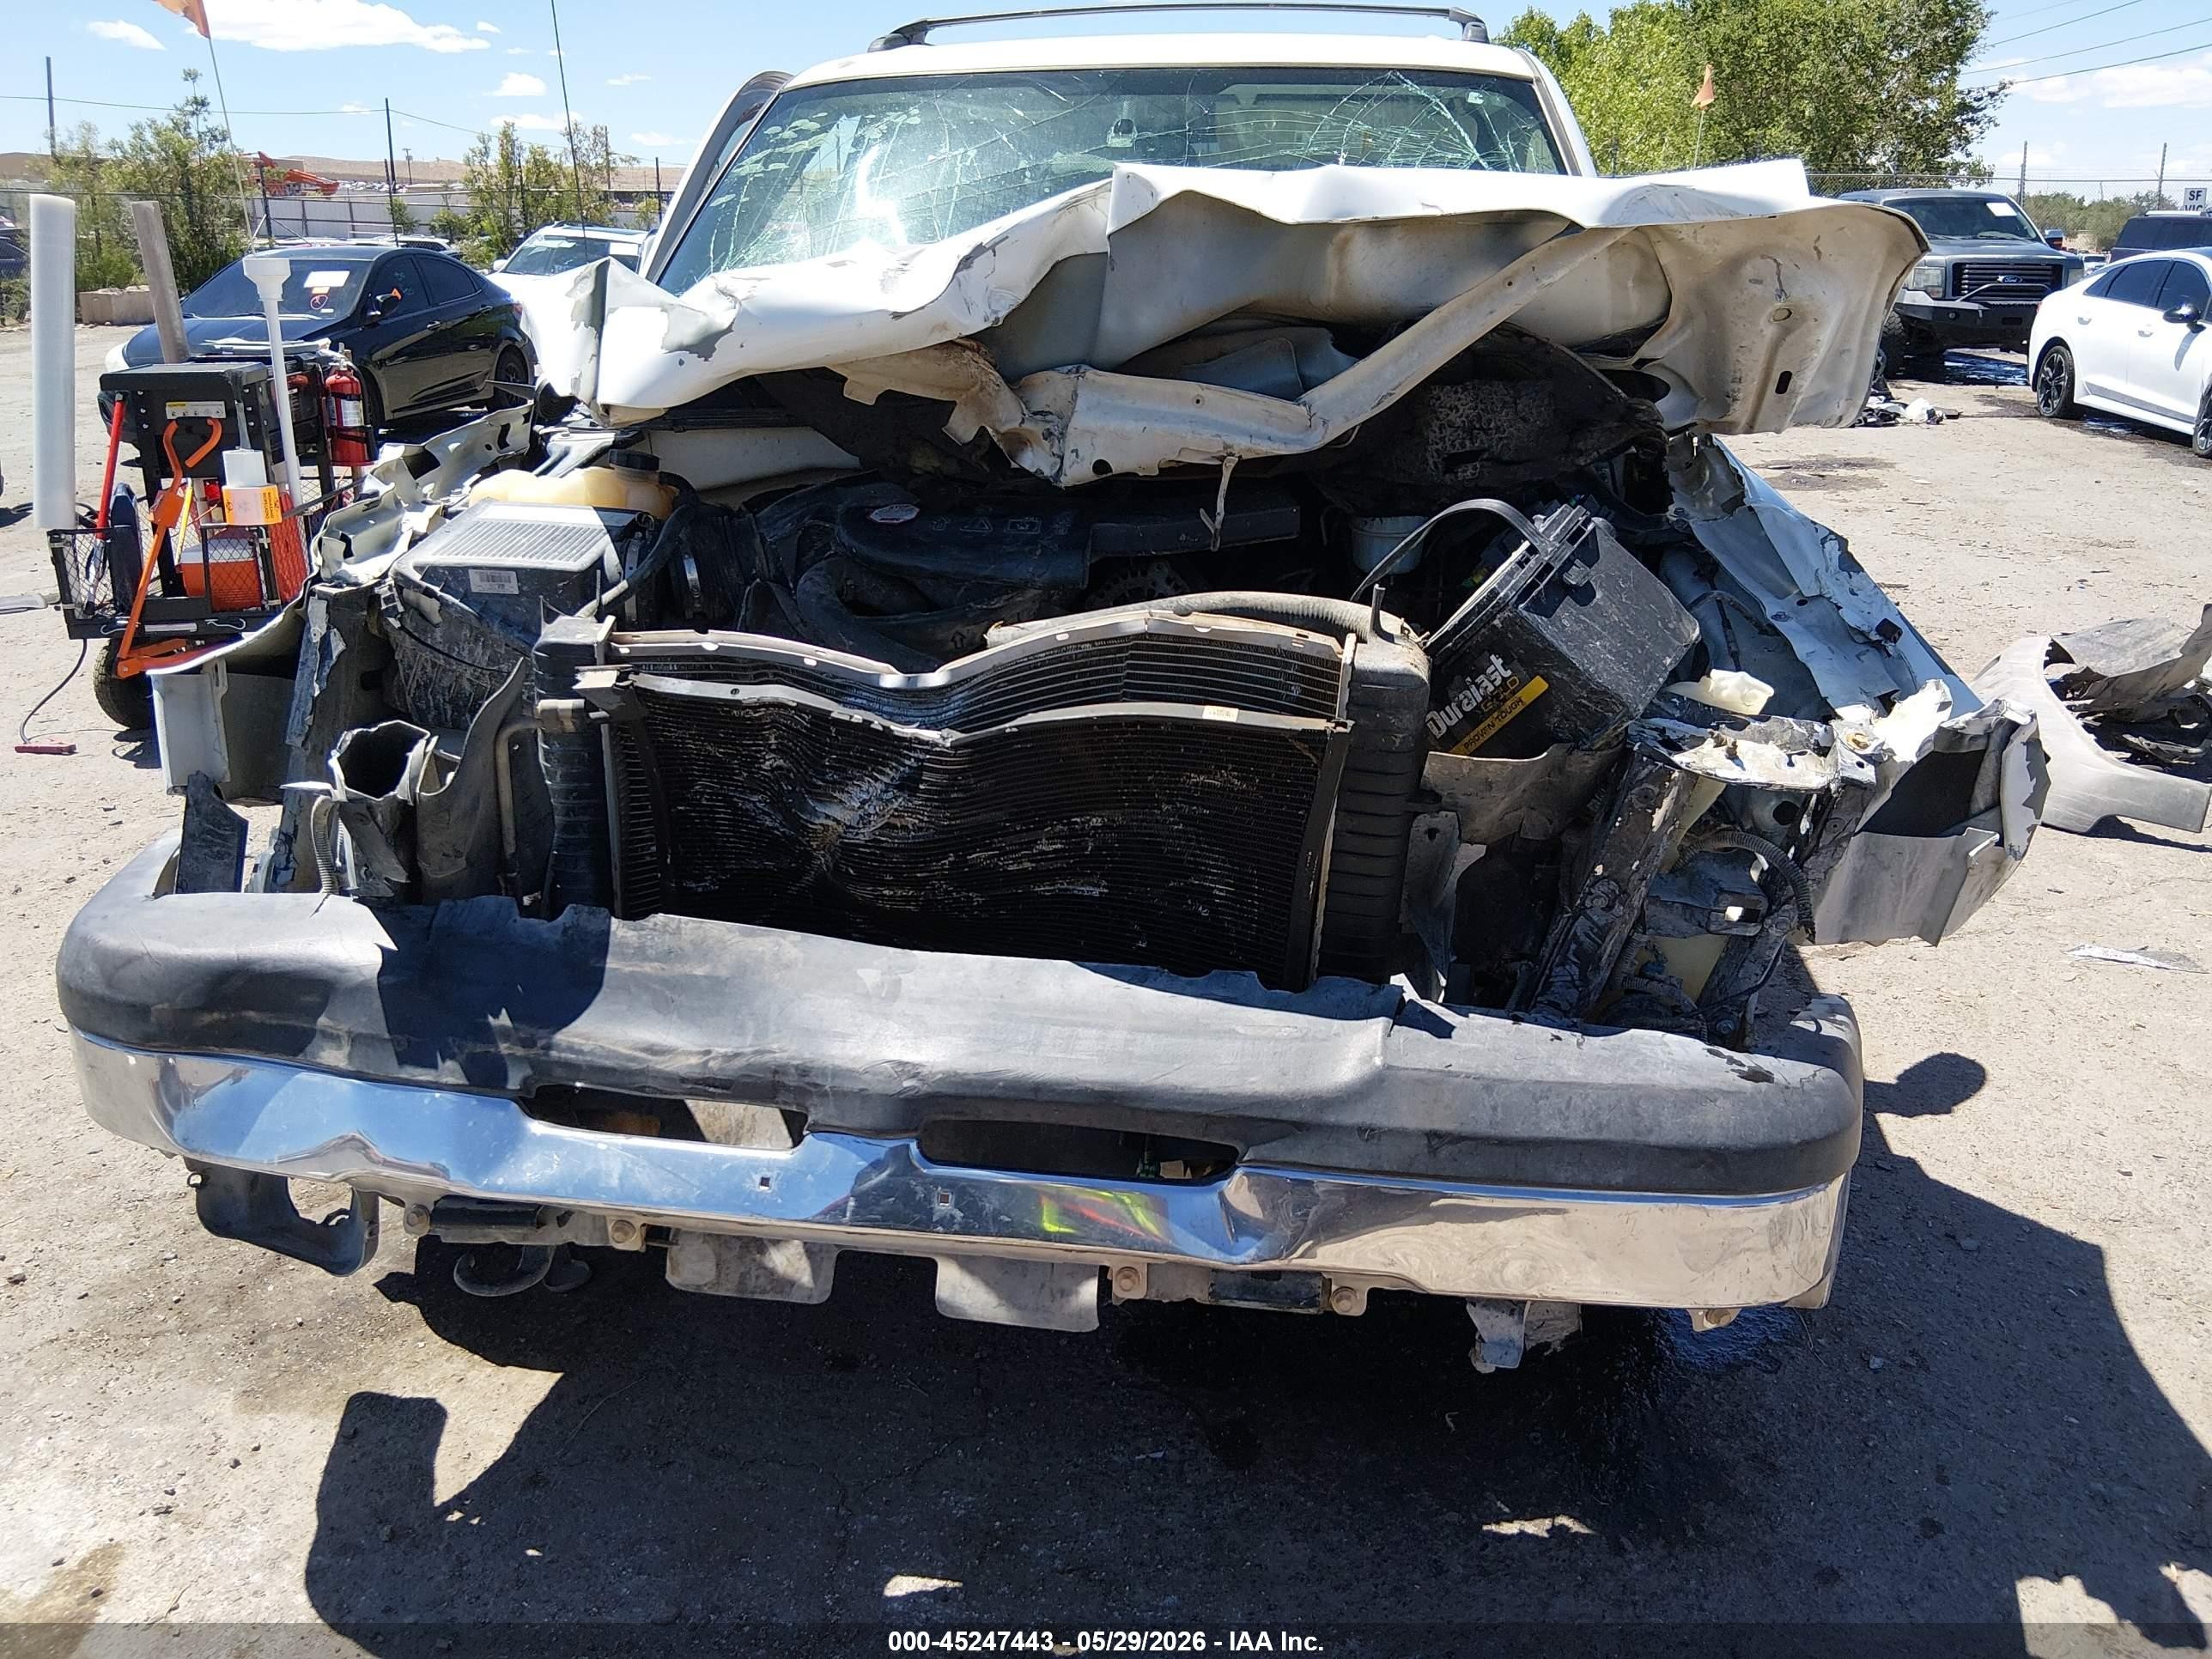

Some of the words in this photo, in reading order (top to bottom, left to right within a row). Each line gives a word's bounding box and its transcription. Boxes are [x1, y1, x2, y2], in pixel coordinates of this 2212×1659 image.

[2189, 190, 2203, 201] SF
[1425, 653, 1512, 739] Duralast
[1495, 696, 1525, 722] TOUGH
